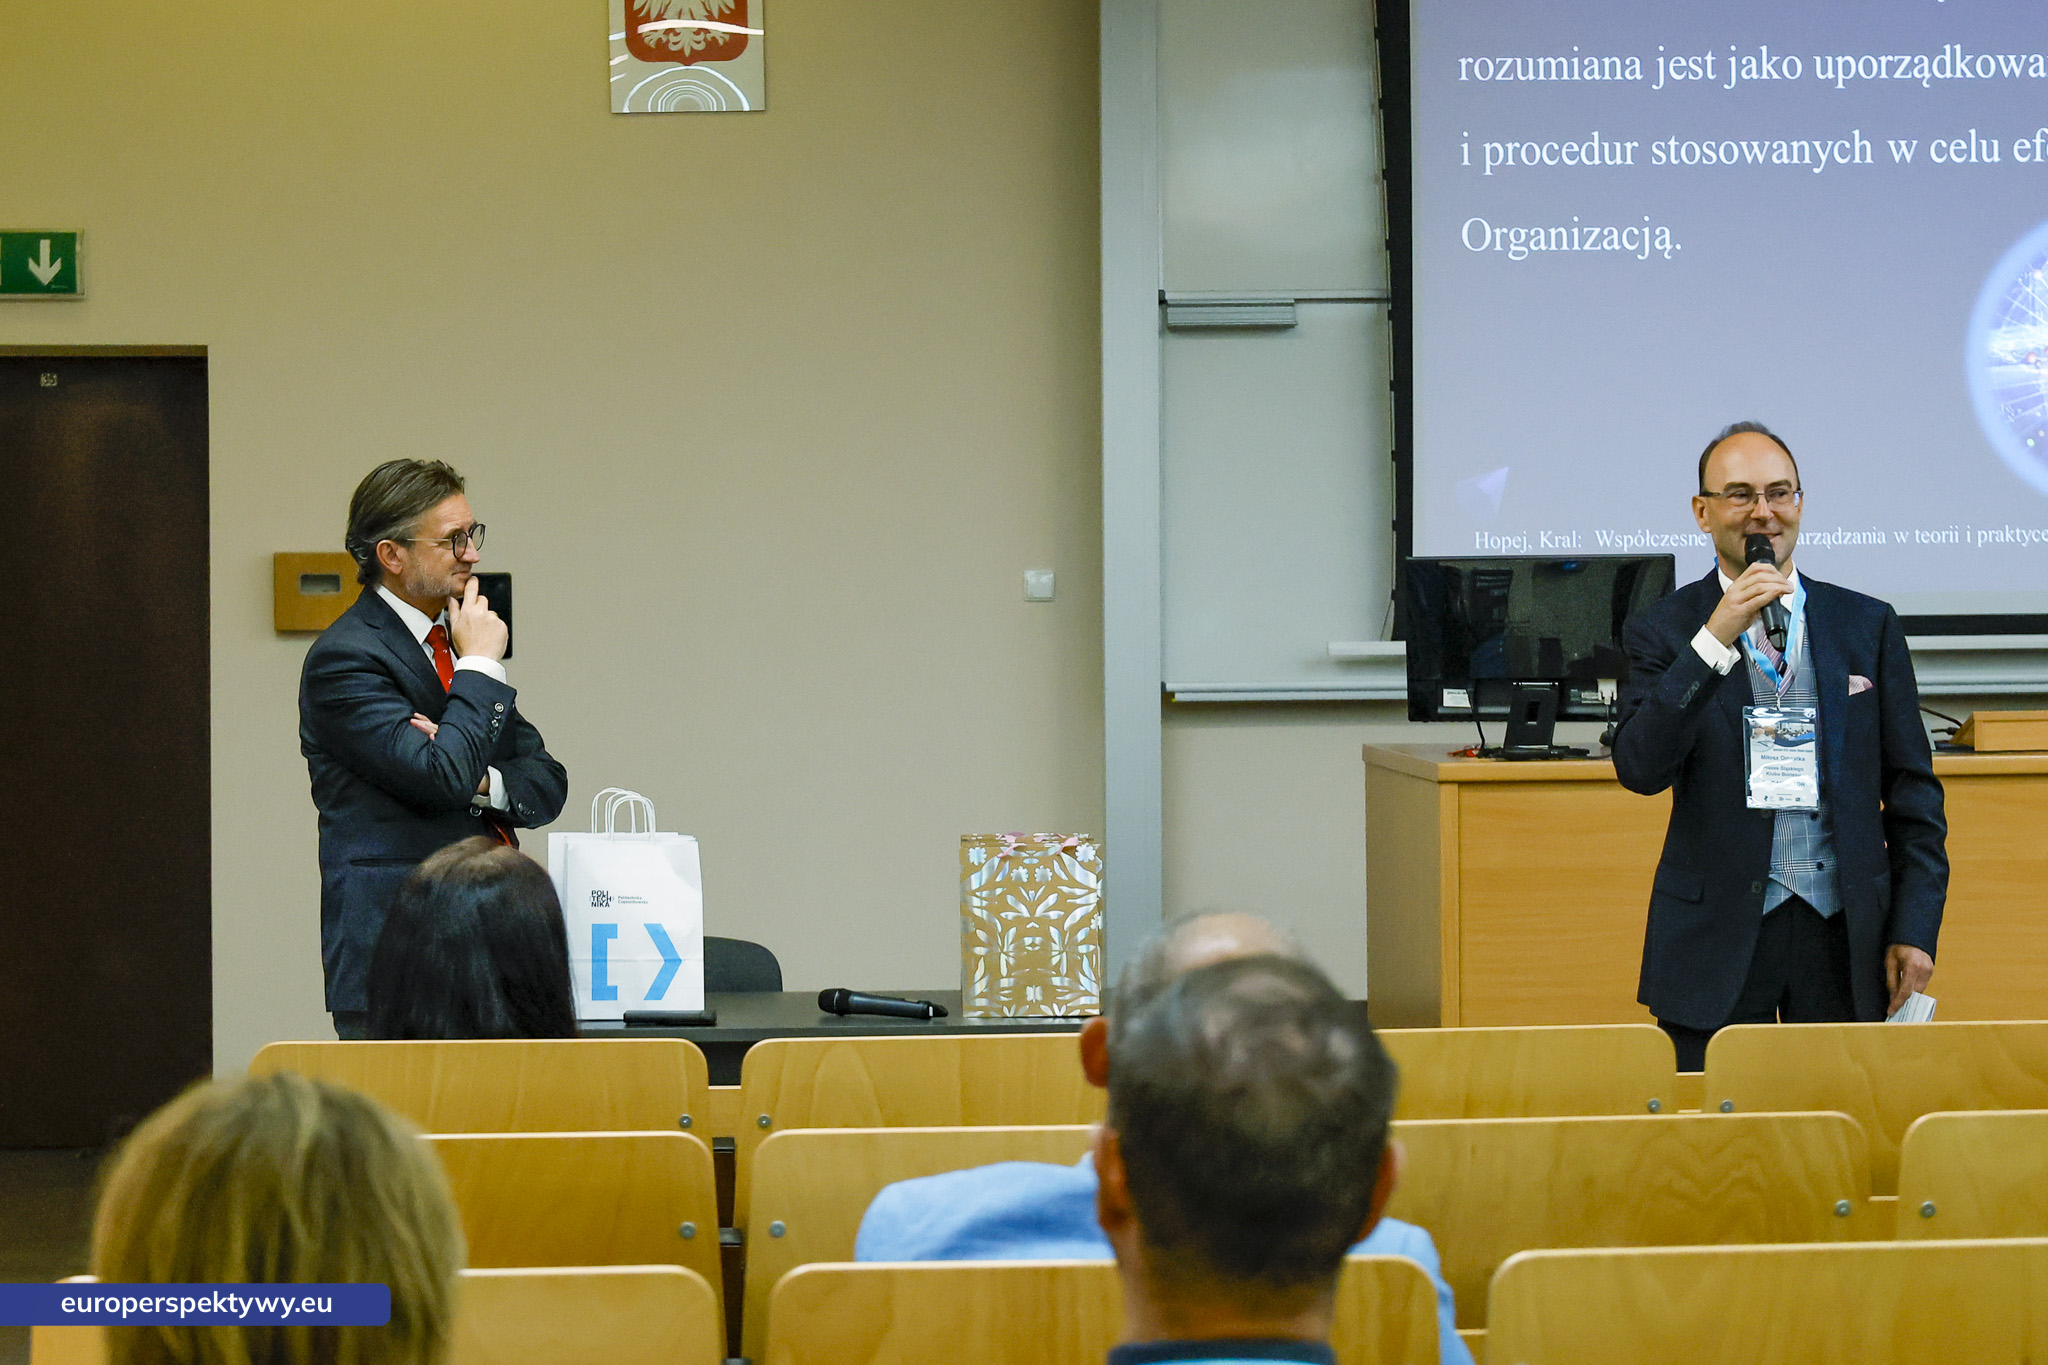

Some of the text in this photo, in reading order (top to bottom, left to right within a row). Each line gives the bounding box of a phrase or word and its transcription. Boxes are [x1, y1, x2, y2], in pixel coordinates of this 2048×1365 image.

[1458, 43, 2048, 90] rozumiana jest jako uporządkowa
[1460, 127, 2048, 176] i procedur stosowanych w celu ef
[1461, 215, 1682, 261] Organizacją.
[1474, 523, 2048, 553] Hopej, Kral: Współczesne arządzania w teorii i praktyce
